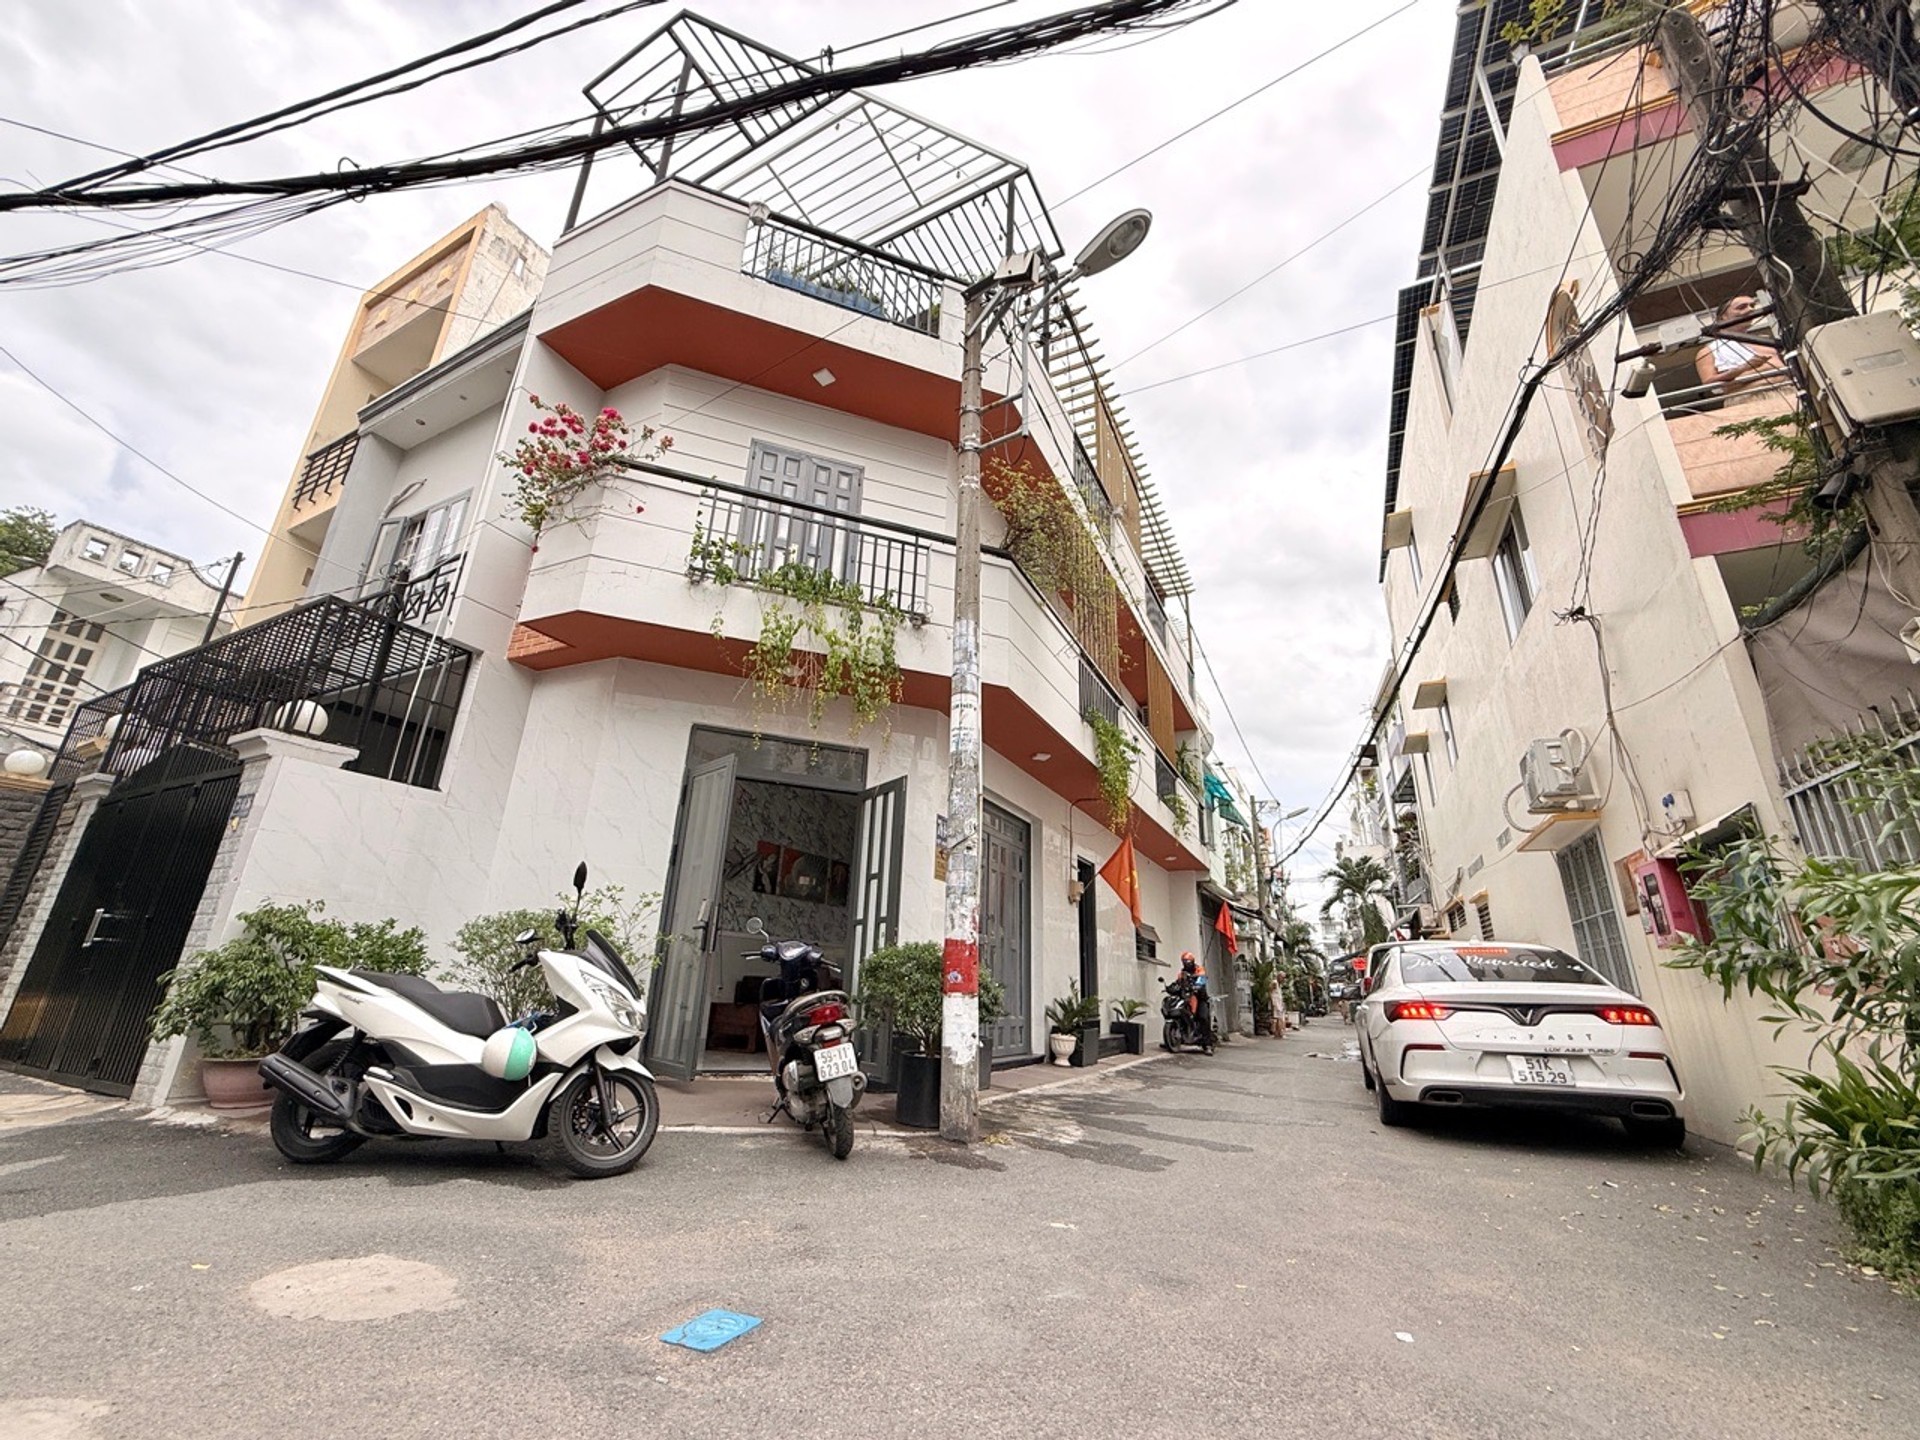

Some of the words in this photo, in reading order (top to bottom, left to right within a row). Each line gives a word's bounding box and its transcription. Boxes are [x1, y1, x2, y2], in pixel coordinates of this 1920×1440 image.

[1407, 956, 1452, 970] Just
[1466, 954, 1560, 970] Married
[1525, 1058, 1552, 1071] 51K
[1518, 1070, 1567, 1084] 515.29
